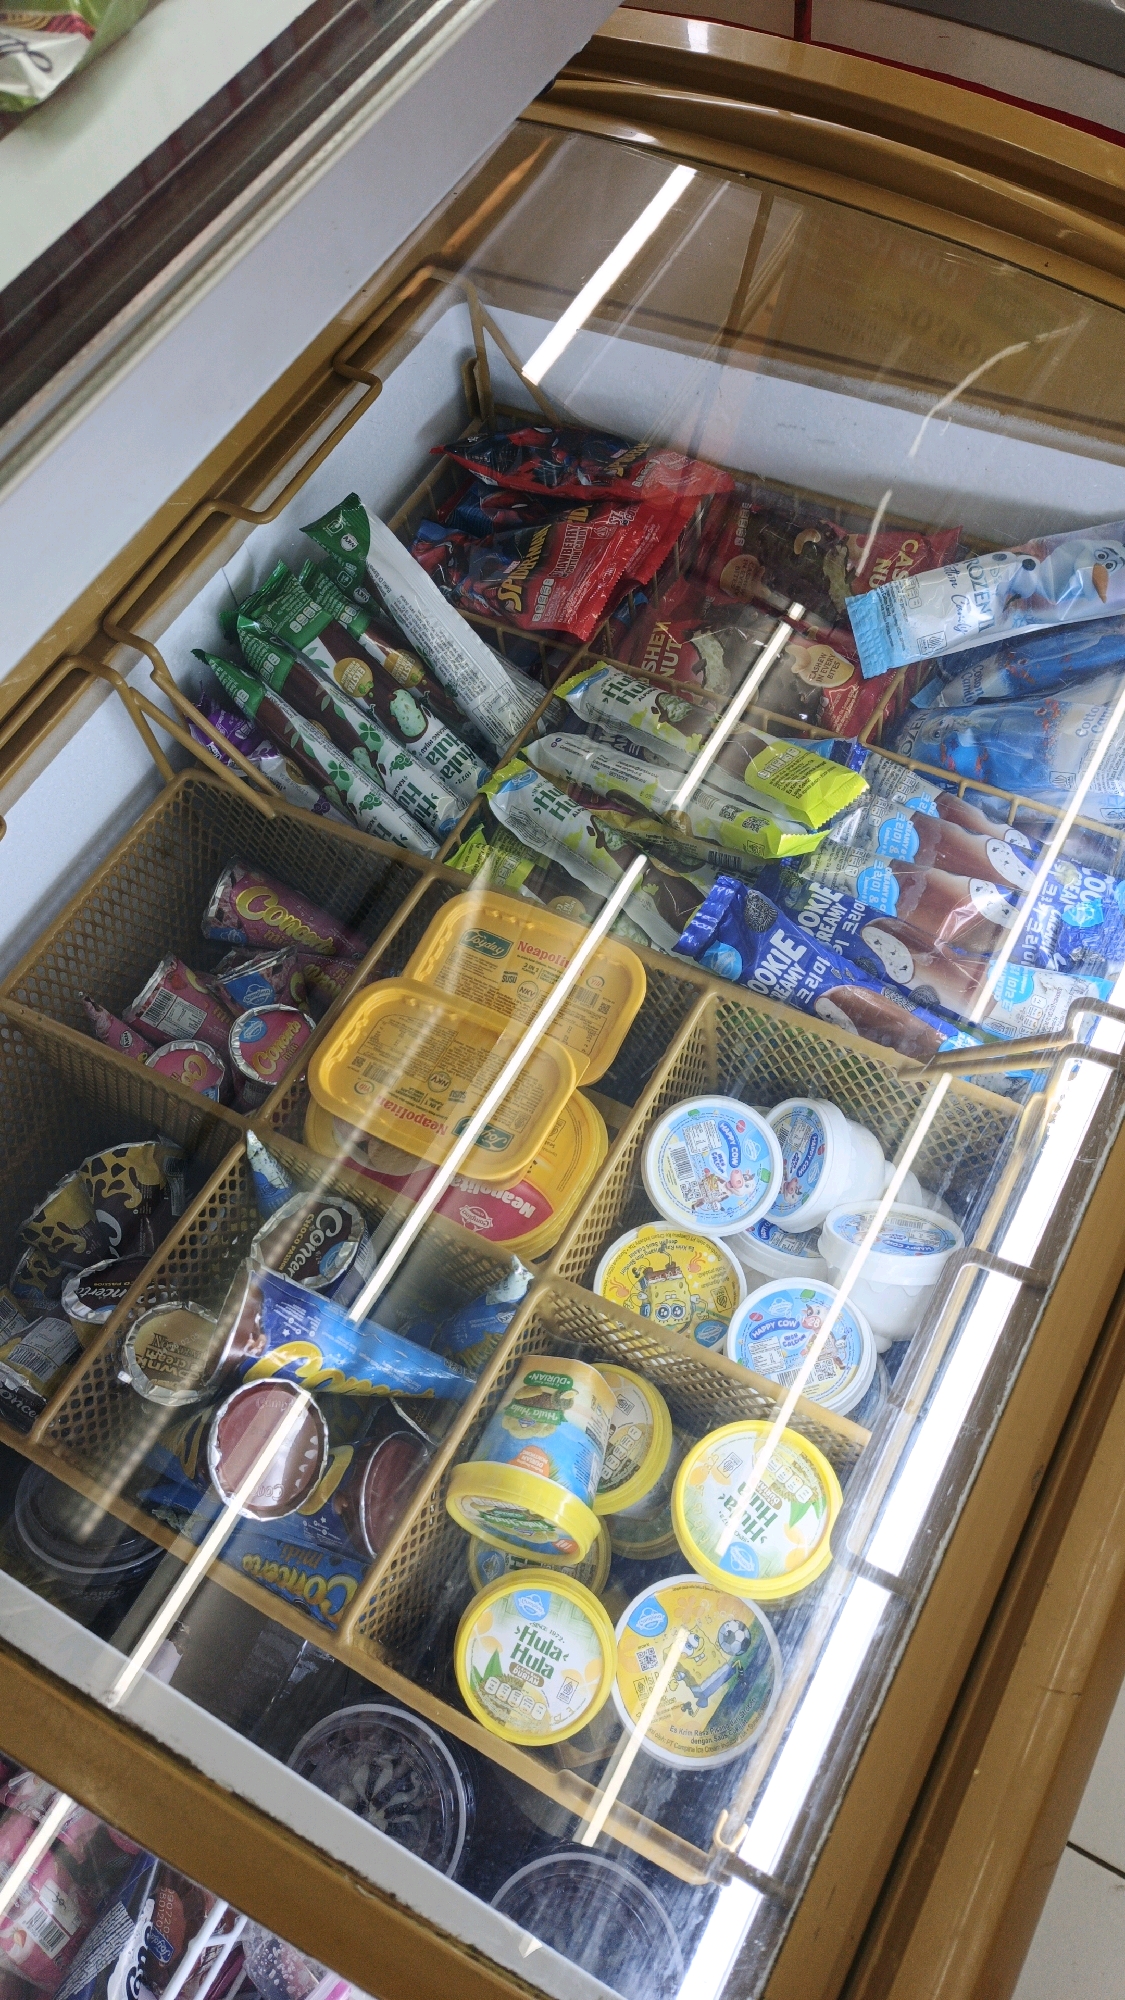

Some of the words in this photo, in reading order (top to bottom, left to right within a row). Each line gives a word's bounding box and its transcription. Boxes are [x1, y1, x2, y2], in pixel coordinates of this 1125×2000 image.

[965, 557, 994, 620] ROZEN
[808, 652, 827, 681] CASHEW
[816, 671, 824, 684] IN
[820, 654, 835, 675] EVERY
[827, 661, 841, 680] BITES
[346, 666, 366, 694] EKSTRA
[236, 886, 337, 956] Concerto
[463, 929, 508, 958] Joyday
[501, 973, 518, 986] SUSU
[518, 986, 536, 998] NKV
[248, 1016, 311, 1079] Concerto
[429, 1075, 450, 1088] NKV
[370, 1094, 451, 1136] Neapolitan
[719, 1123, 736, 1146] HAPPY
[731, 1146, 740, 1167] COW
[752, 1321, 775, 1338] HAPPY
[777, 1320, 798, 1328] COW
[531, 1372, 567, 1386] DURIAN
[509, 1404, 532, 1417] Hula
[532, 1408, 559, 1422] Hula
[638, 1612, 665, 1628] Campina
[518, 1625, 564, 1661] Hula
[510, 1642, 555, 1679] Hula
[512, 1668, 540, 1686] DURIAN
